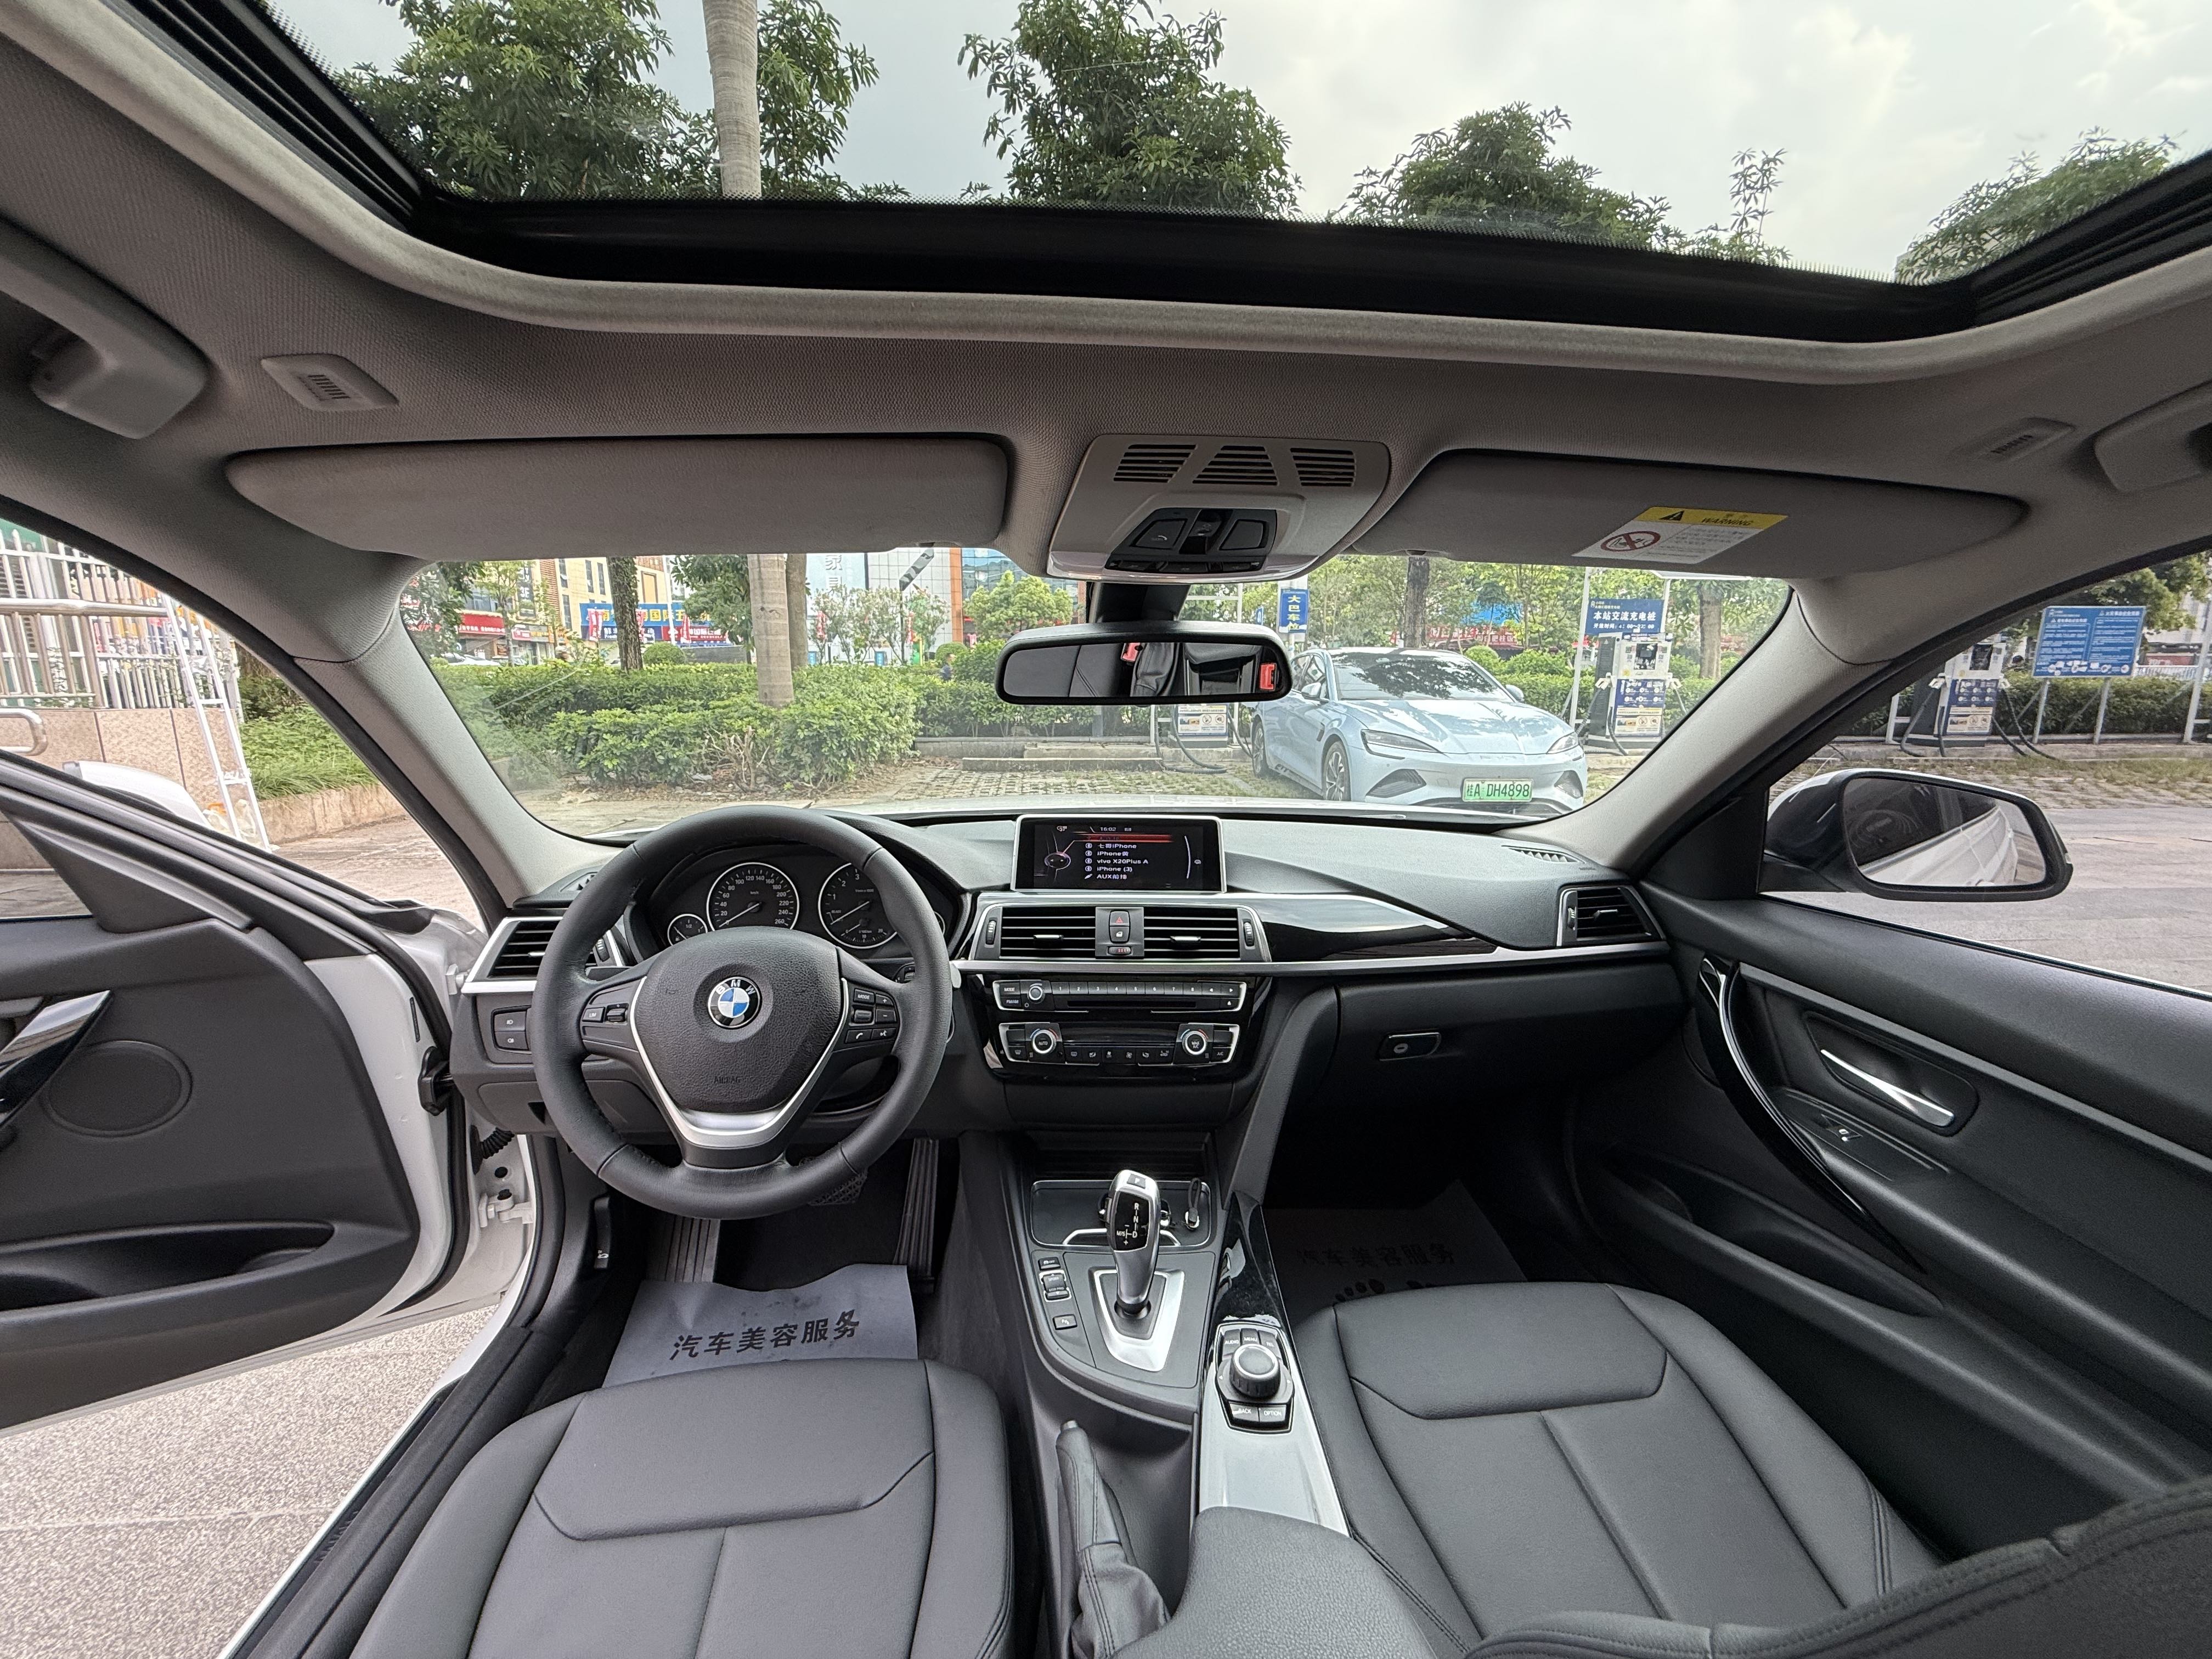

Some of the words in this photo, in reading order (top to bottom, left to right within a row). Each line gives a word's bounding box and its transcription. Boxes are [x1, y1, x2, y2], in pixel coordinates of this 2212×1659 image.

[1701, 517, 1754, 526] WARNING
[1593, 611, 1656, 621] 本站交流充电桩
[1467, 783, 1480, 797] 桂A
[1486, 783, 1530, 797] DH4898
[715, 979, 756, 995] BMW
[669, 1309, 860, 1361] 汽车美容服务
